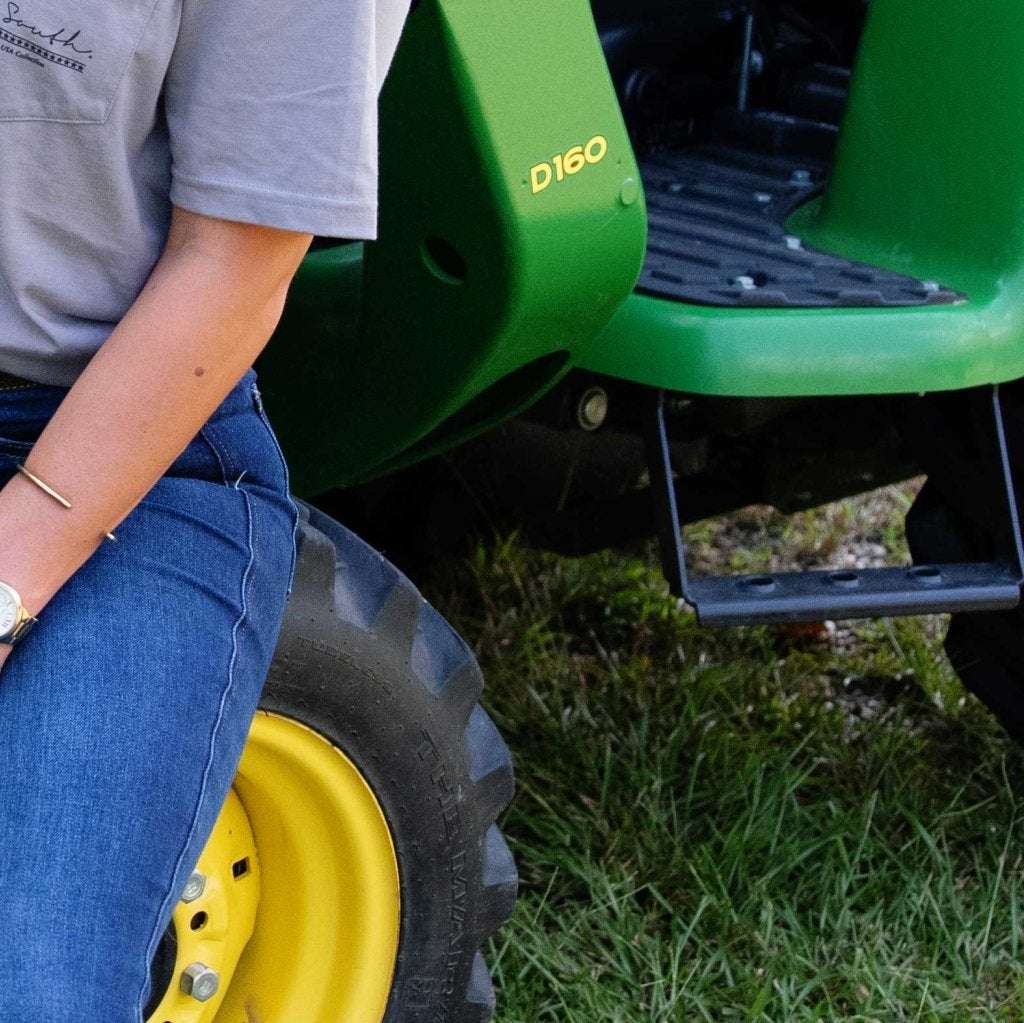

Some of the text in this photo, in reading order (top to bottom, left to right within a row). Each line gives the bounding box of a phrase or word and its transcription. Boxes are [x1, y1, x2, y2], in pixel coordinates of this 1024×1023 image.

[1, 44, 13, 54] USA
[15, 51, 44, 68] Collection
[529, 134, 608, 195] D160
